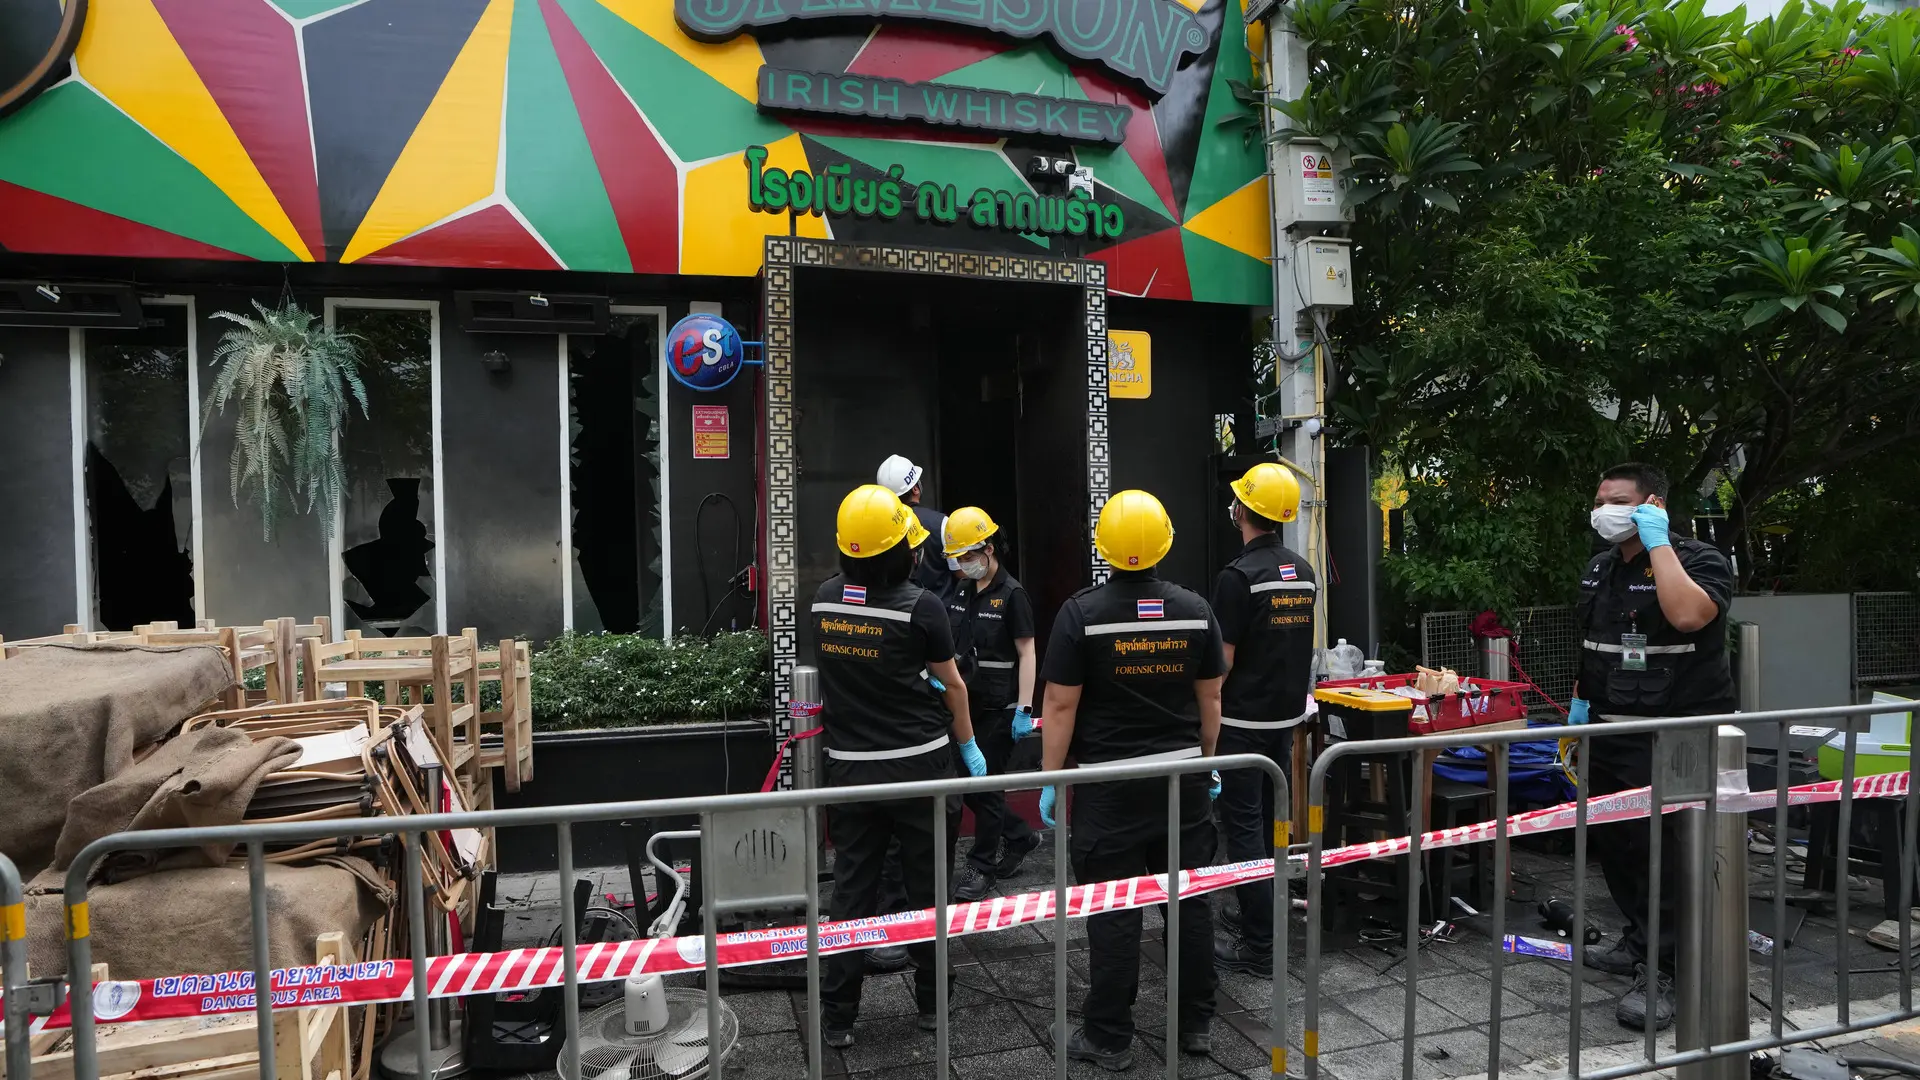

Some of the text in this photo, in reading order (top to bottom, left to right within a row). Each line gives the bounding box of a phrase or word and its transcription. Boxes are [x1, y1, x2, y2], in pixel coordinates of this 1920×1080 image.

[768, 72, 1125, 137] IRISH WHISKEY
[747, 146, 1125, 238] โรงเบียร์ ณ ลาดพร้าว
[673, 327, 734, 376] est
[718, 361, 735, 373] COLA
[904, 466, 917, 486] DPT
[821, 643, 879, 658] FORENSIC POLICE
[1115, 663, 1185, 675] FORENSIC POLICE
[771, 929, 888, 955] DANGROUS AREA
[201, 986, 341, 1011] DANGEOUS AREA
